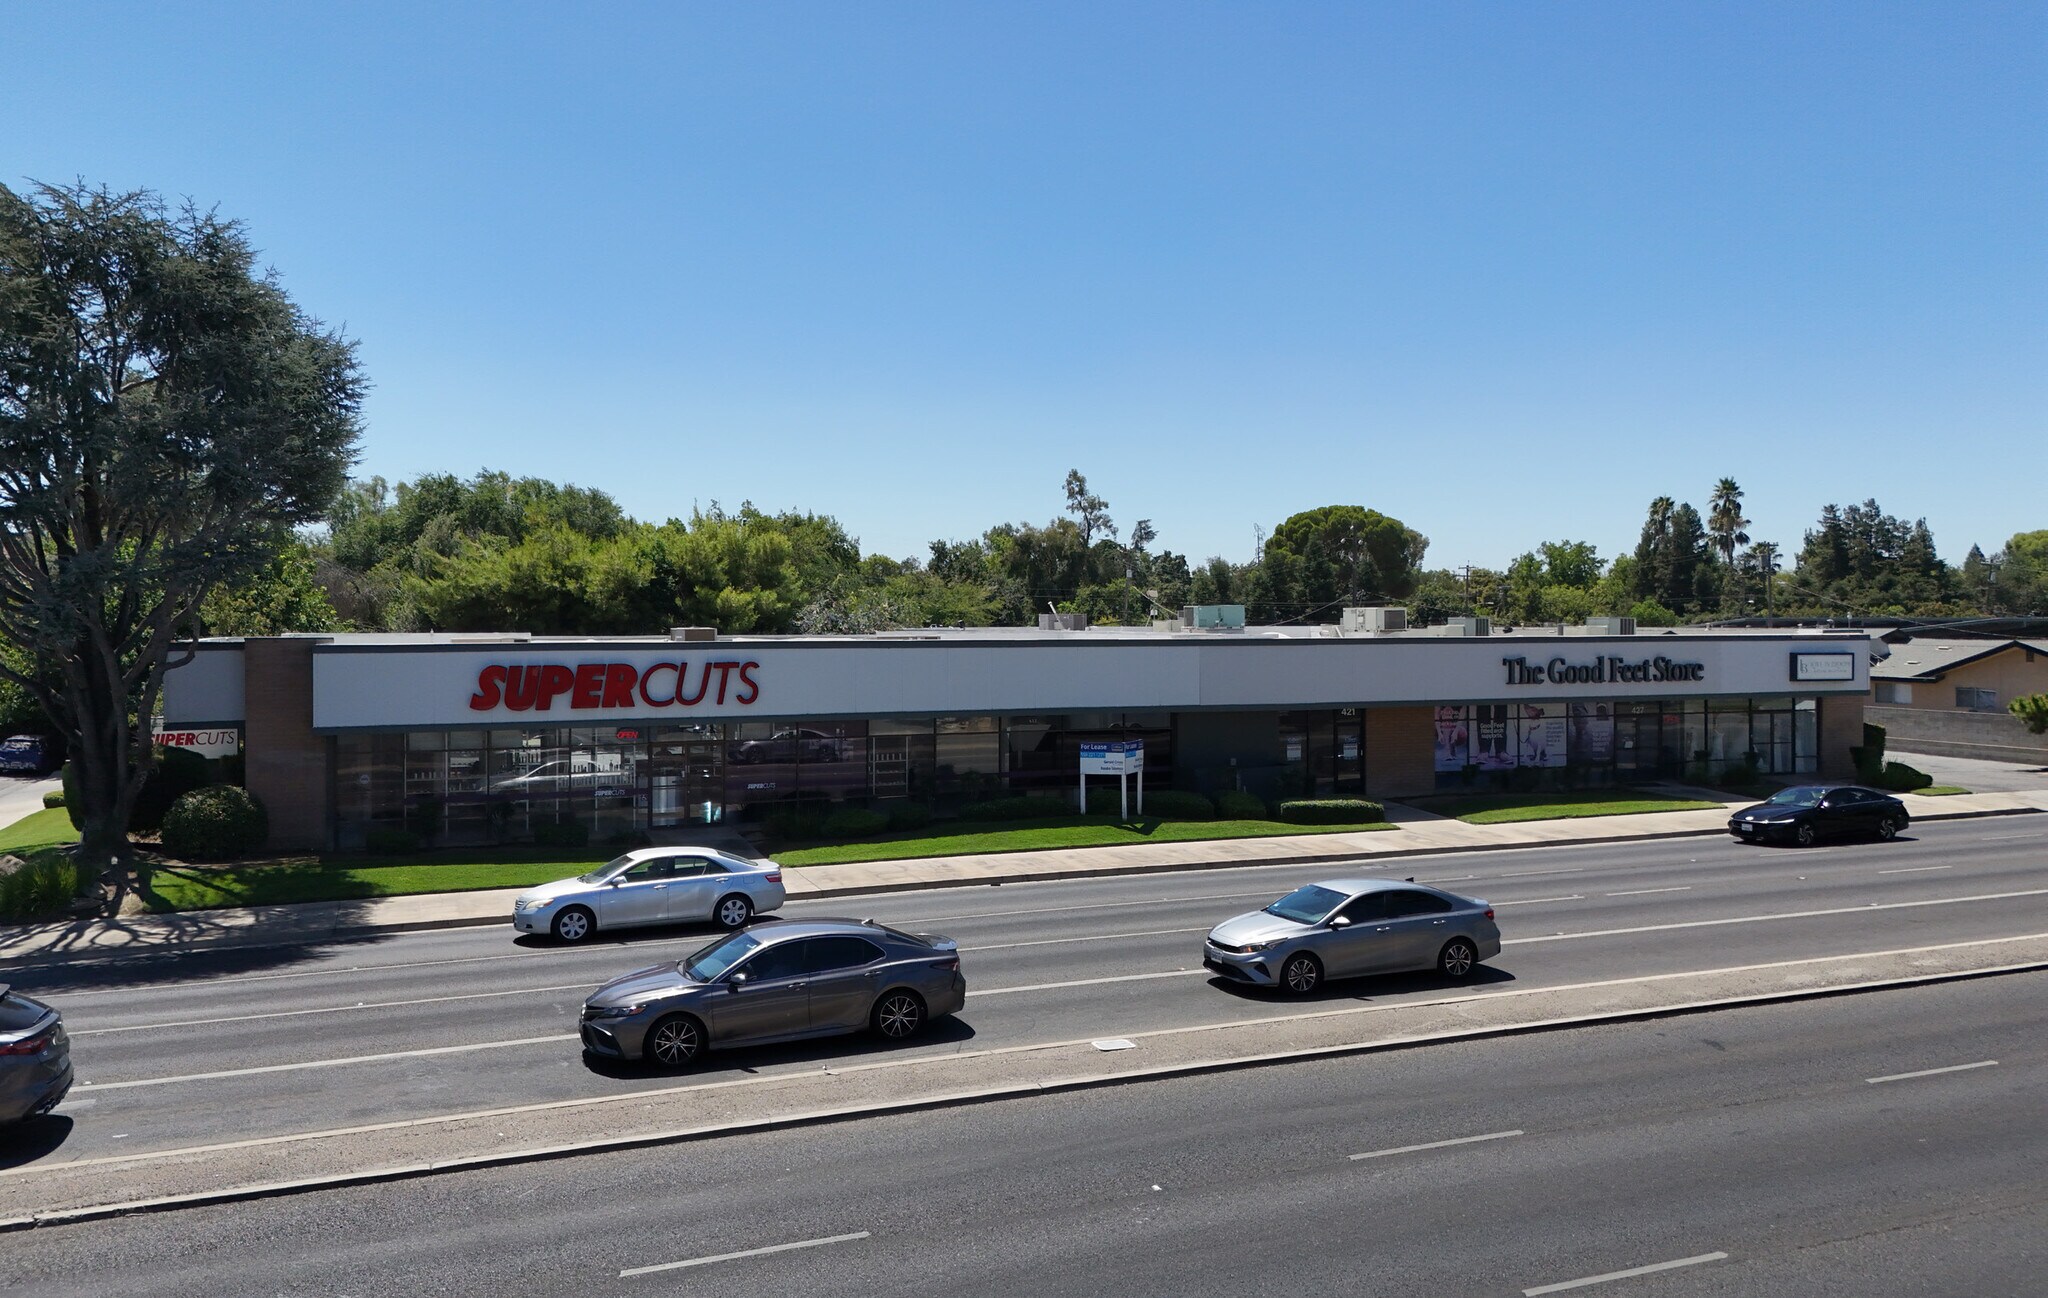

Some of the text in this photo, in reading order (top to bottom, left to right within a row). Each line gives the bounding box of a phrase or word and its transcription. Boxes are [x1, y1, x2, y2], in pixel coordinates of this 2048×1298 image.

[1503, 656, 1704, 685] The Good Feet Store
[469, 661, 760, 711] SUPERCUTS
[1341, 708, 1356, 716] 421
[1631, 706, 1644, 714] 427
[617, 731, 639, 739] OPEN
[594, 789, 626, 797] SUPERCUTS
